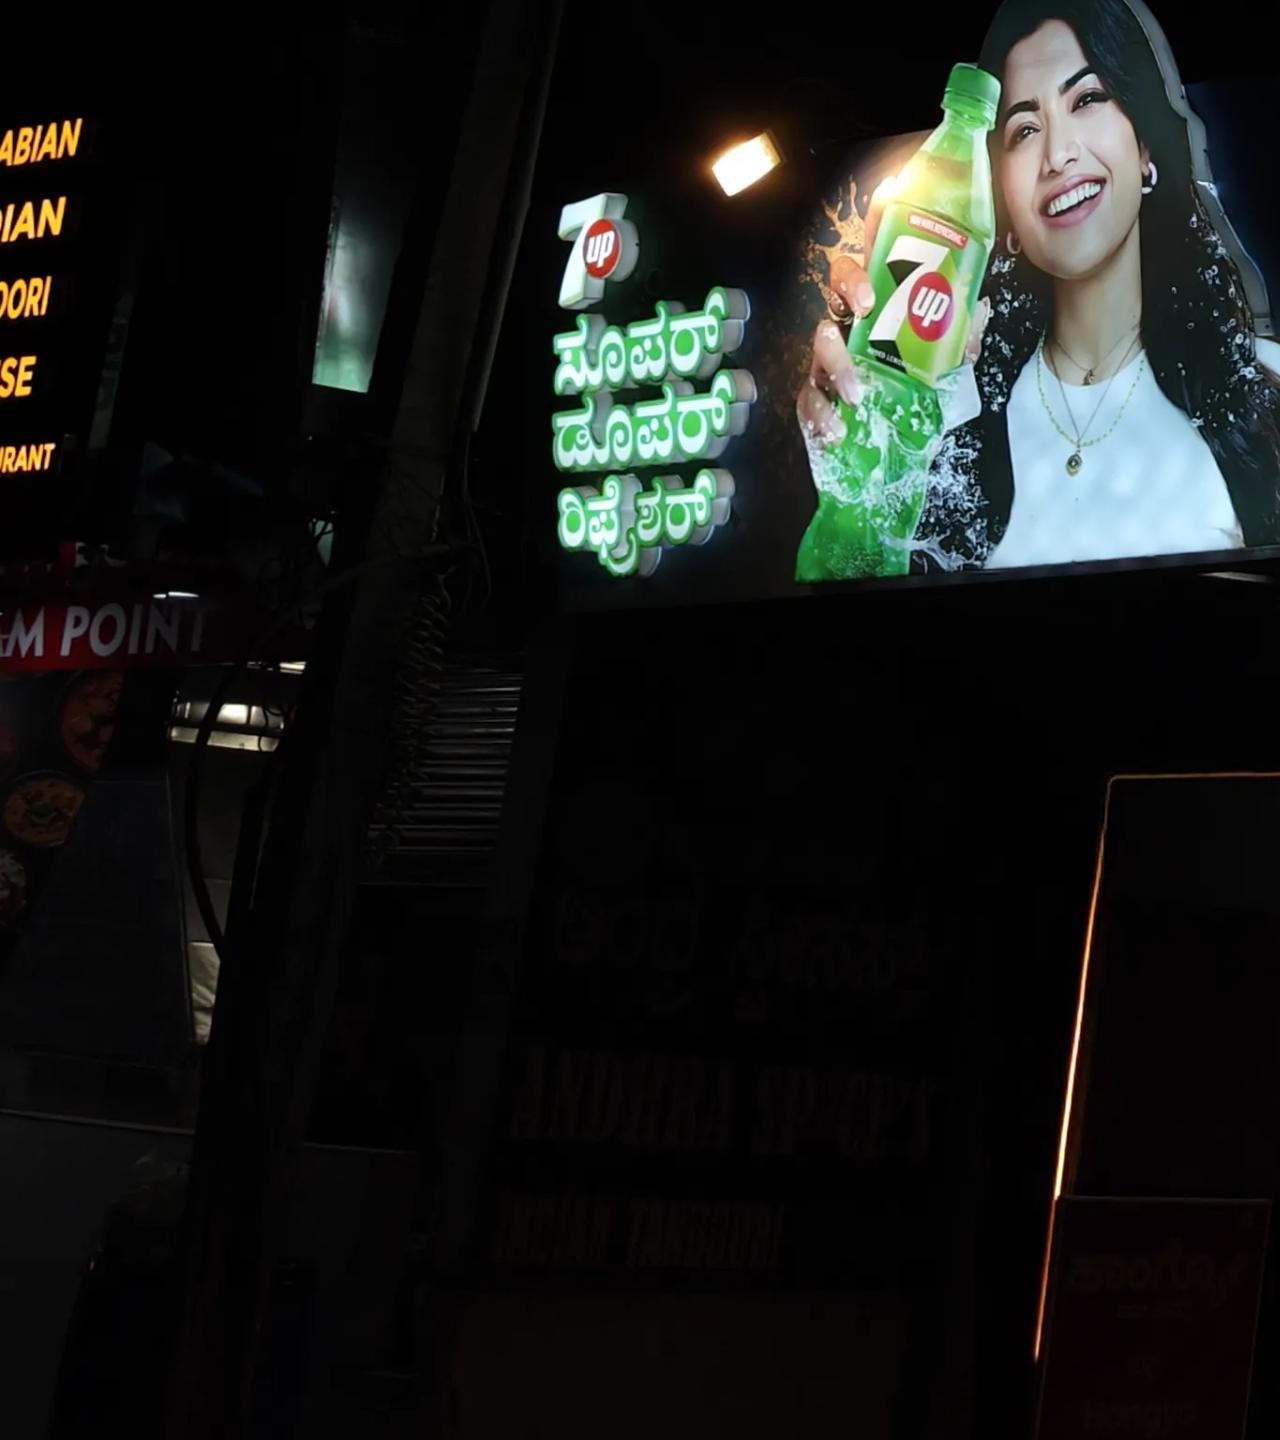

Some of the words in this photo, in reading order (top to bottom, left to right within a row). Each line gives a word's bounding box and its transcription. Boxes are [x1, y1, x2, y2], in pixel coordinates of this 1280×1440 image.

[0, 196, 67, 244] IAN
[0, 356, 37, 399] SE
[552, 286, 734, 396] ಸೂಪರ್
[552, 368, 740, 472] ಡೂಪರ್
[60, 602, 208, 658] POINT
[511, 1046, 736, 1150] ANDHRA
